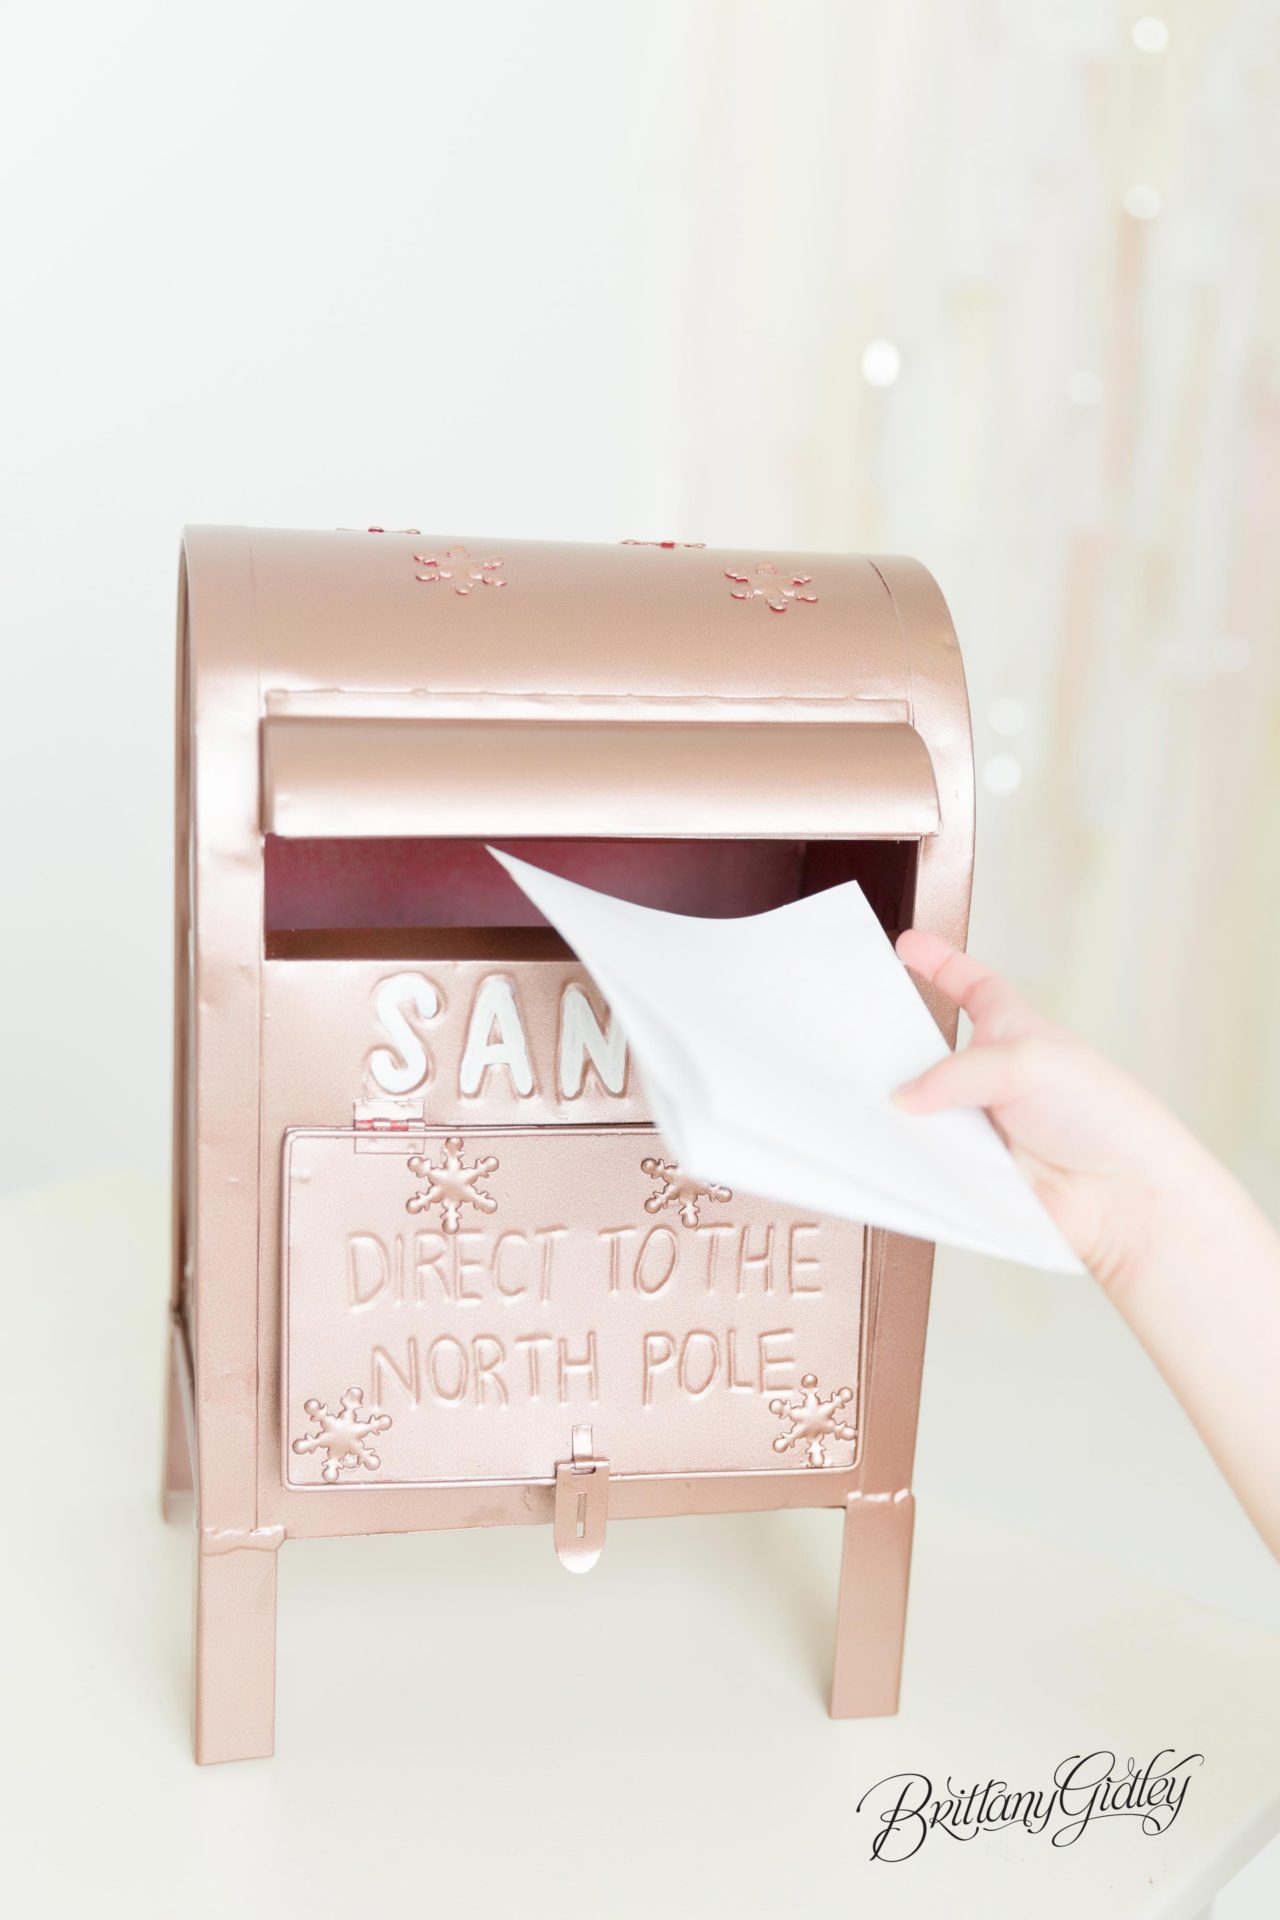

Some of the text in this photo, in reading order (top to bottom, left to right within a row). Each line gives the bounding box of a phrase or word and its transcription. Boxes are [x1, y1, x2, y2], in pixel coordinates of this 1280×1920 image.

[346, 1221, 823, 1312] DIRECT TO THE
[370, 1328, 797, 1409] NORTH POLE
